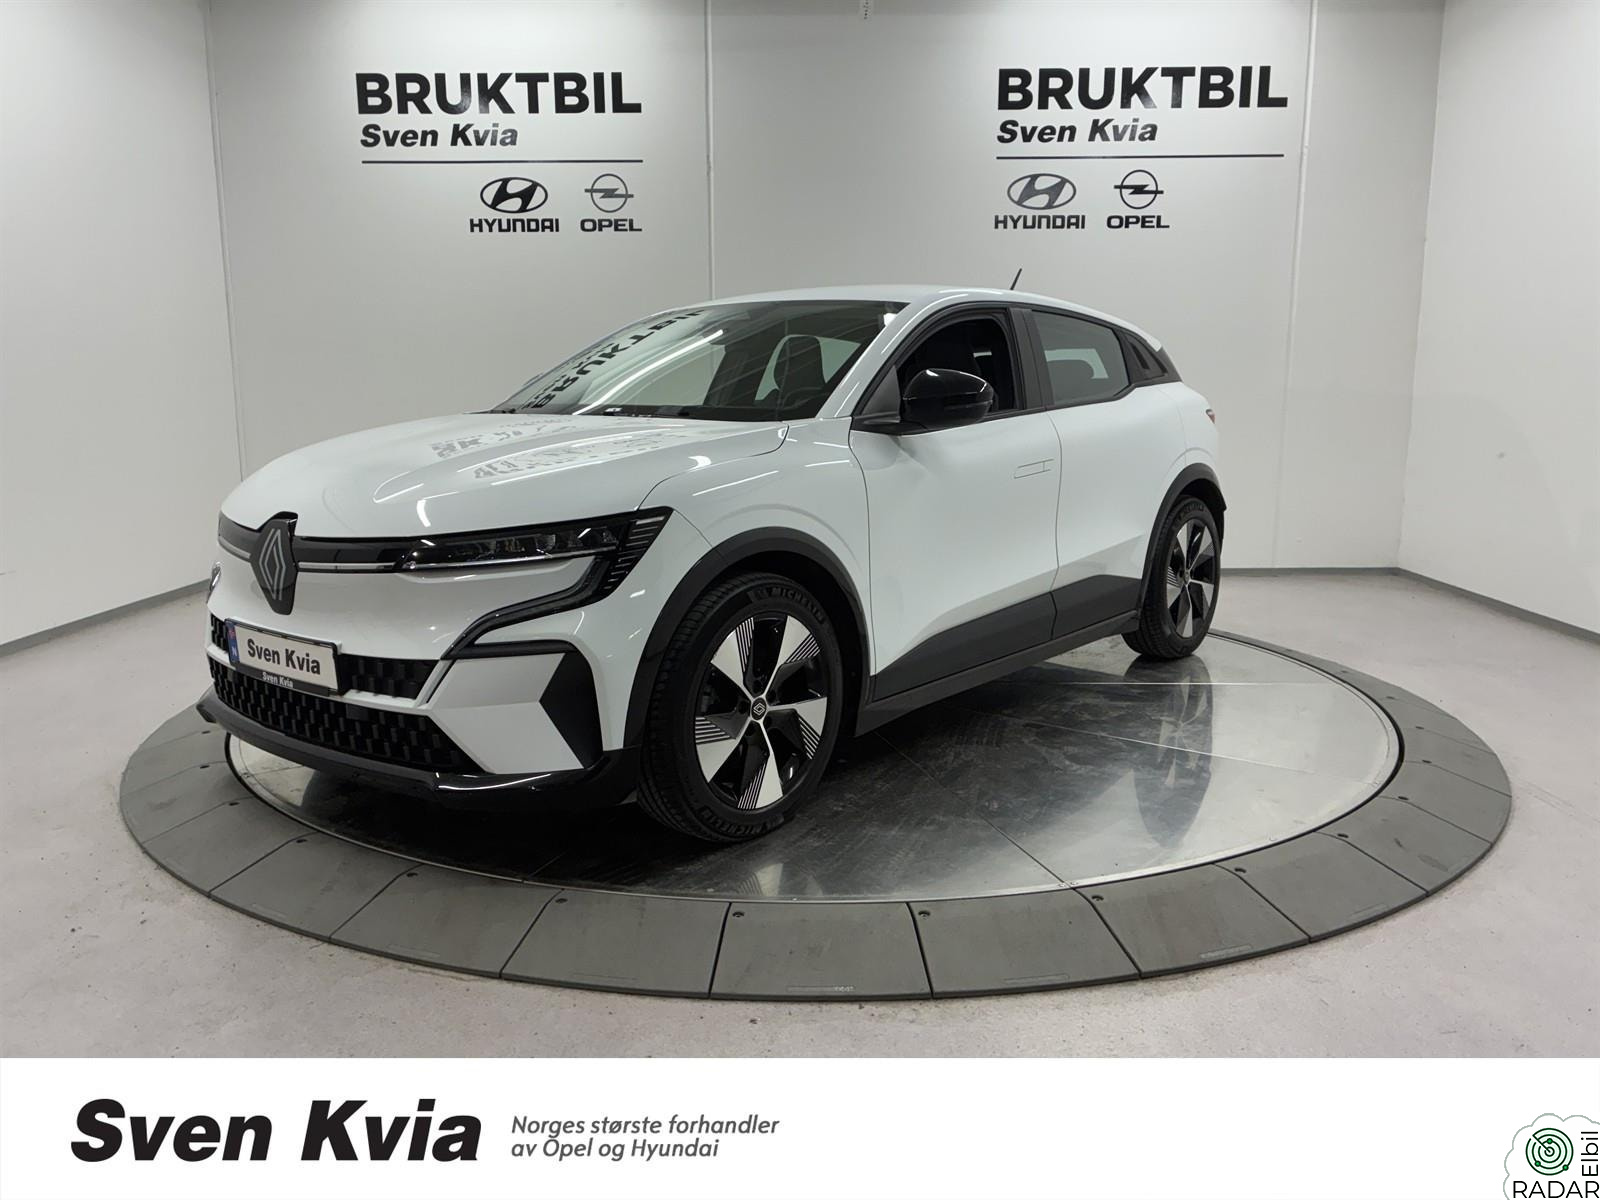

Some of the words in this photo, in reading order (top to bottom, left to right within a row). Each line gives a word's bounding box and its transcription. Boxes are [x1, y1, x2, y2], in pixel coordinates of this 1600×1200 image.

[355, 71, 643, 115] BRUKTBIL
[997, 65, 1289, 111] BRUKTBIL
[360, 123, 439, 147] Sven
[450, 123, 518, 147] Kvia
[996, 119, 1077, 144] Sven
[1088, 118, 1158, 142] Kvia
[469, 218, 560, 233] HYUNDAI
[580, 218, 643, 232] OPEL
[994, 214, 1086, 230] HYUNDAI
[1106, 214, 1170, 229] OPEL
[770, 586, 826, 625] MICHELIN
[247, 638, 281, 665] Sven
[285, 648, 321, 675] Kvia
[262, 671, 280, 684] Sven
[279, 676, 294, 688] Kvia
